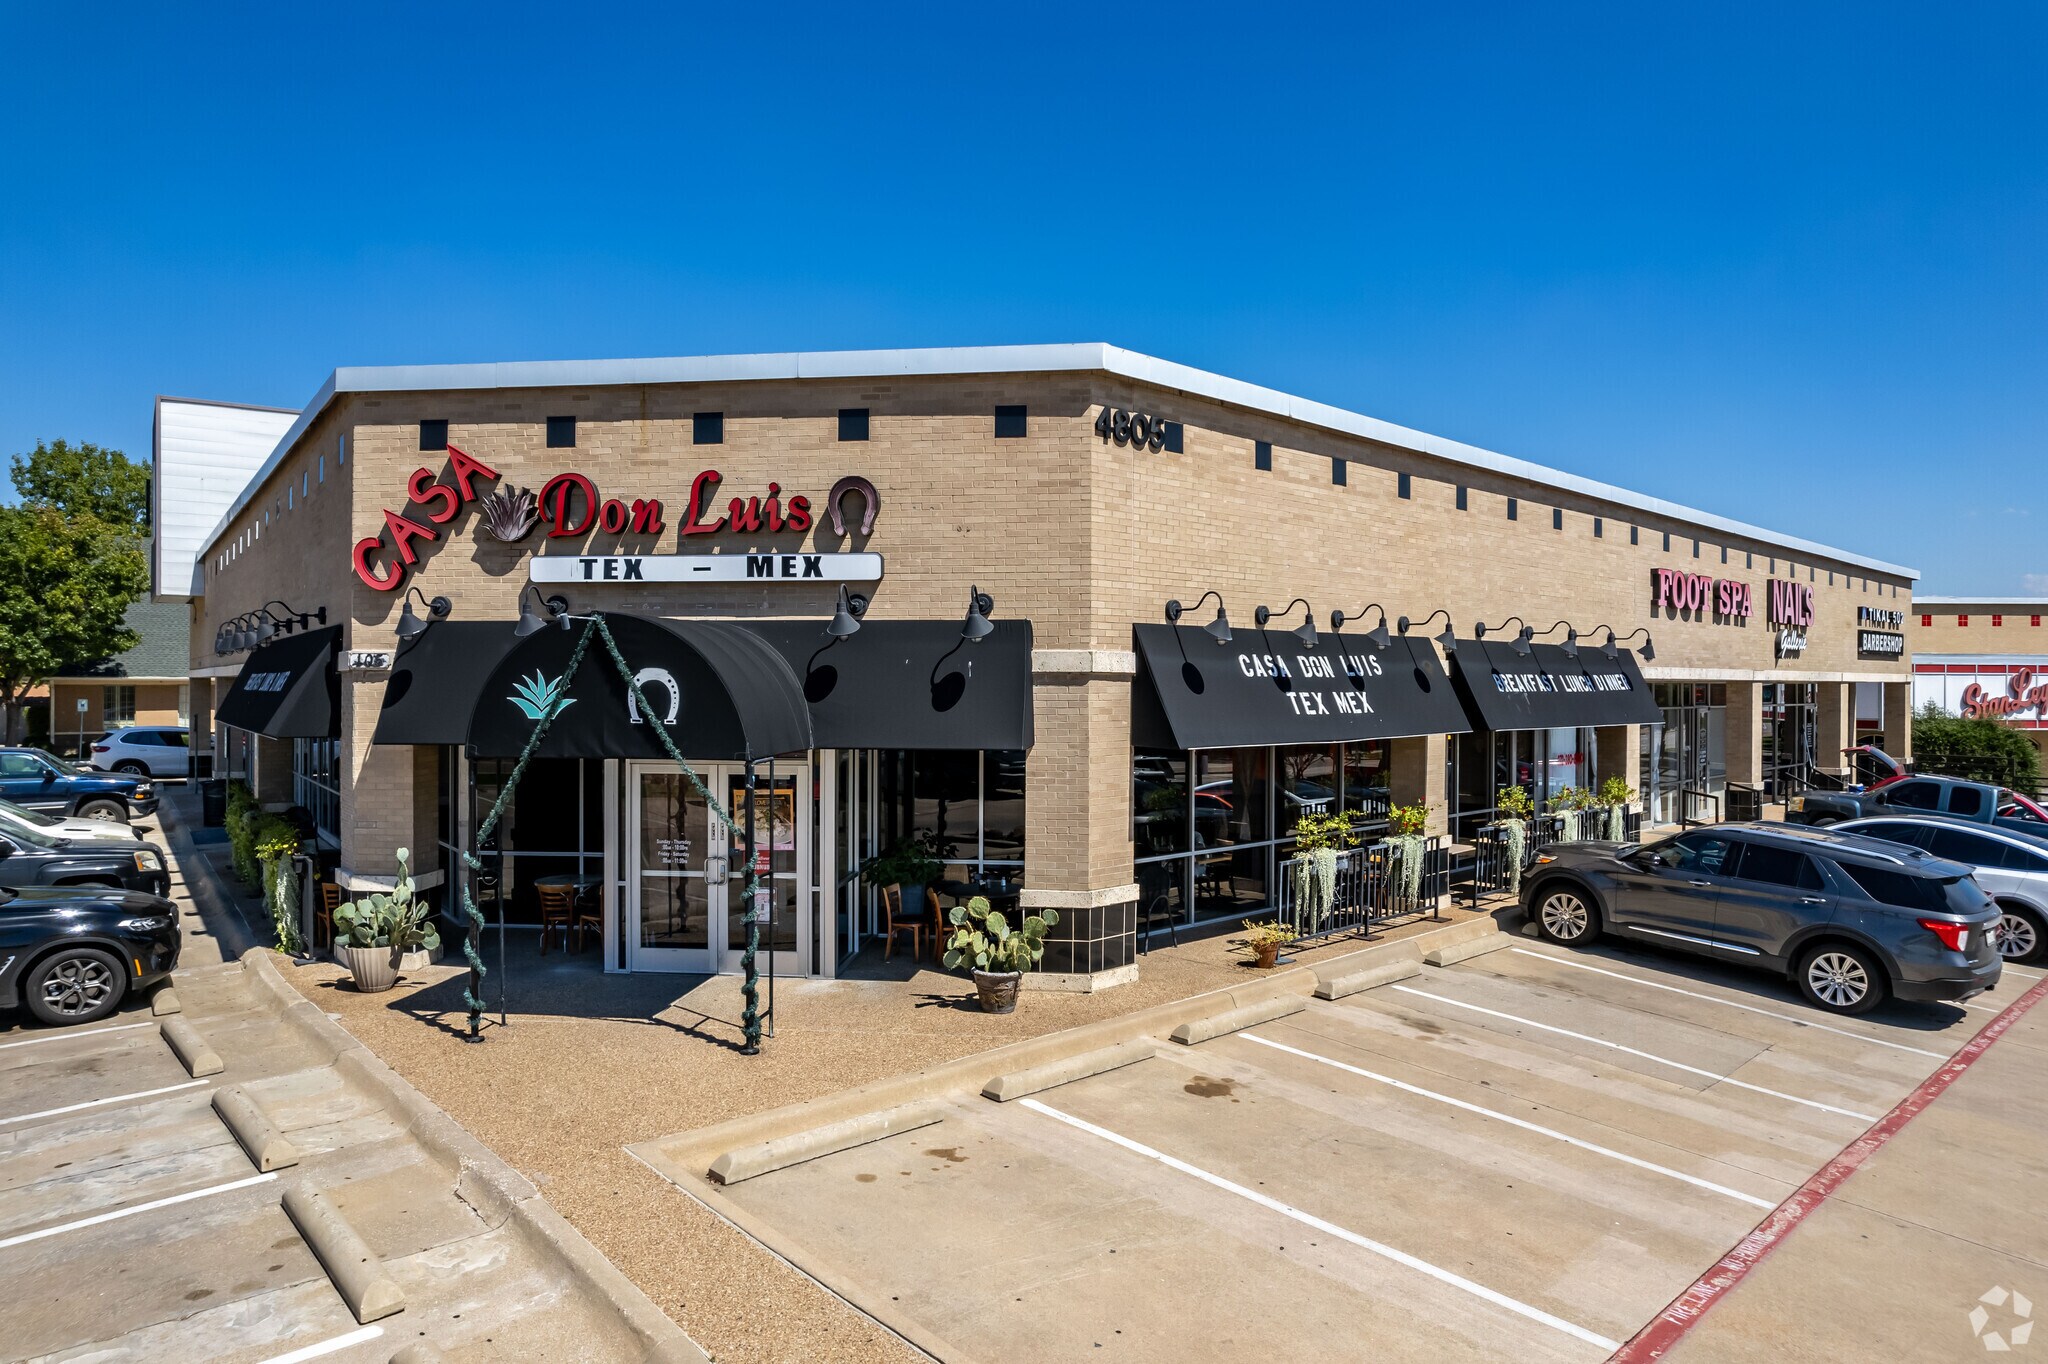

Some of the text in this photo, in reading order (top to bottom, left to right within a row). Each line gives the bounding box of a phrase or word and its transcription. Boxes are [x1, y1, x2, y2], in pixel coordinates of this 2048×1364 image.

[1095, 407, 1164, 448] 4805
[538, 470, 812, 537] Don Luis
[353, 443, 501, 591] CASA
[579, 558, 644, 580] TEX
[746, 555, 823, 578] MEX
[1657, 568, 1754, 617] FOOT SPA
[1771, 578, 1815, 628] NAILS
[1868, 607, 1905, 625] TIKAL 502
[1862, 633, 1903, 653] BARBERSHOP
[1238, 653, 1383, 678] CASA DON LUIS
[1491, 673, 1632, 692] BREAKFAST LUNCH DINNER
[1286, 691, 1375, 715] TEX MEX
[1683, 1280, 1721, 1306] LANE
